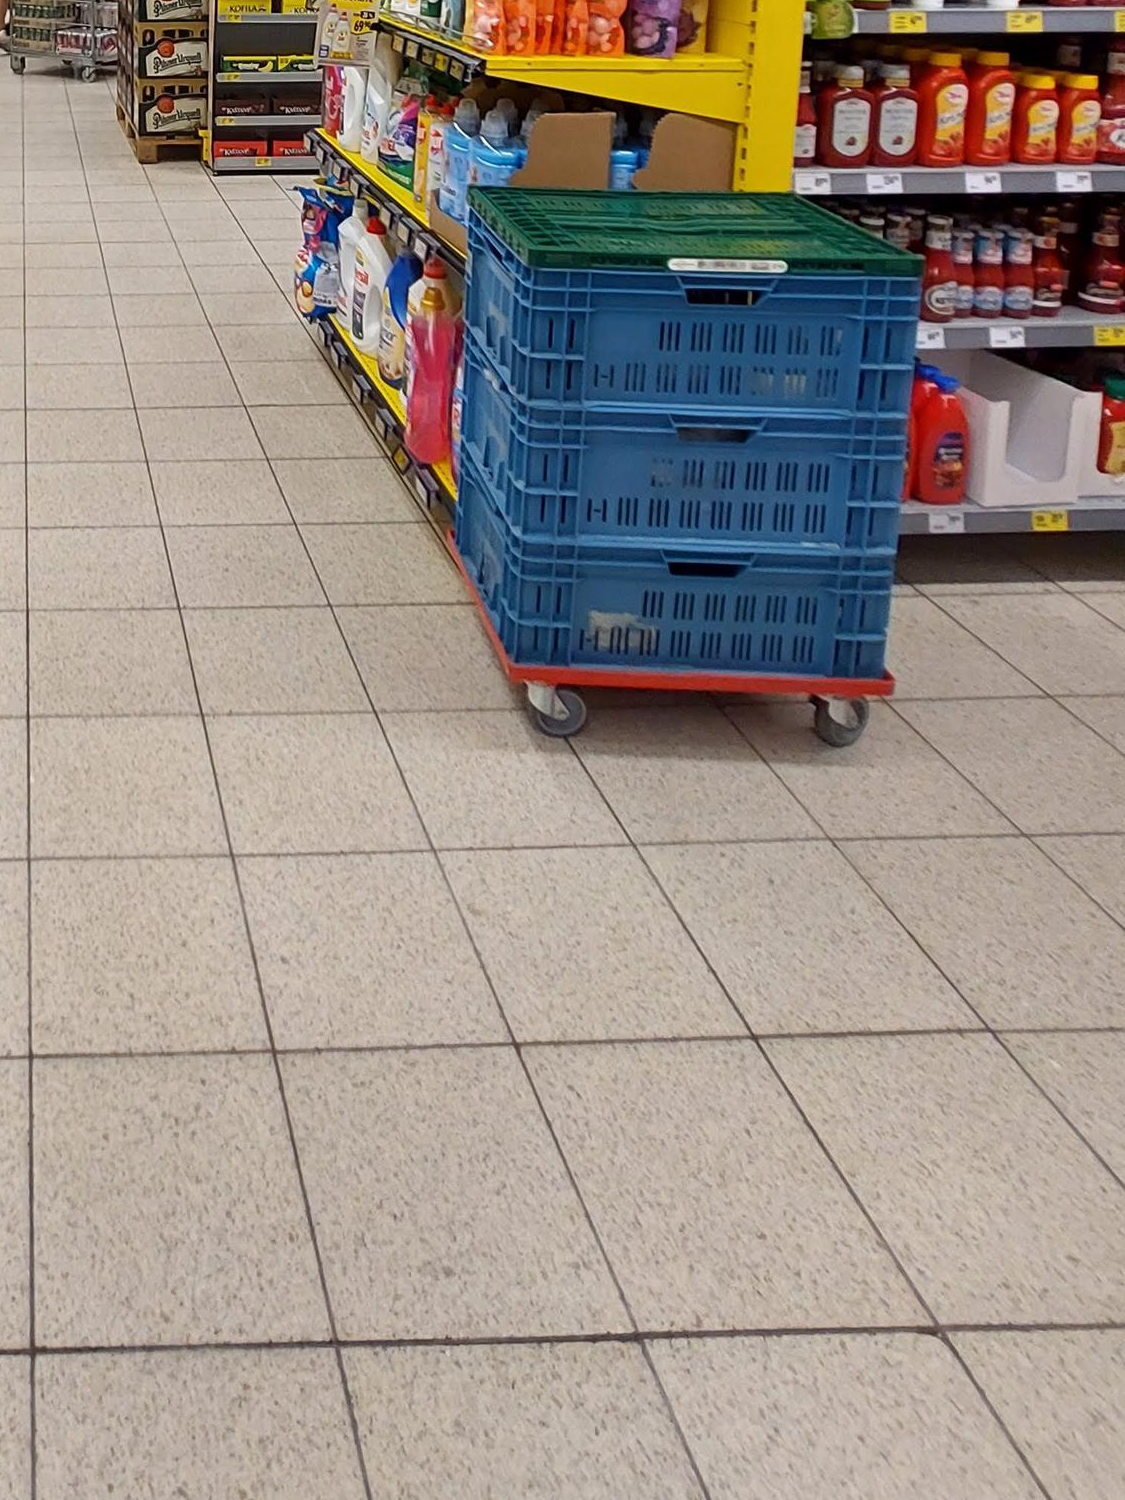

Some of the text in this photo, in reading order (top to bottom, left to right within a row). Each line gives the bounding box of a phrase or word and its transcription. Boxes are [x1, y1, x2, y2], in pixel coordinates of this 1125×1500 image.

[153, 0, 177, 18] Pilsner
[230, 4, 258, 13] KOFILA
[153, 52, 202, 74] Pilsner Urquell
[152, 108, 201, 130] Pilsner Urquell
